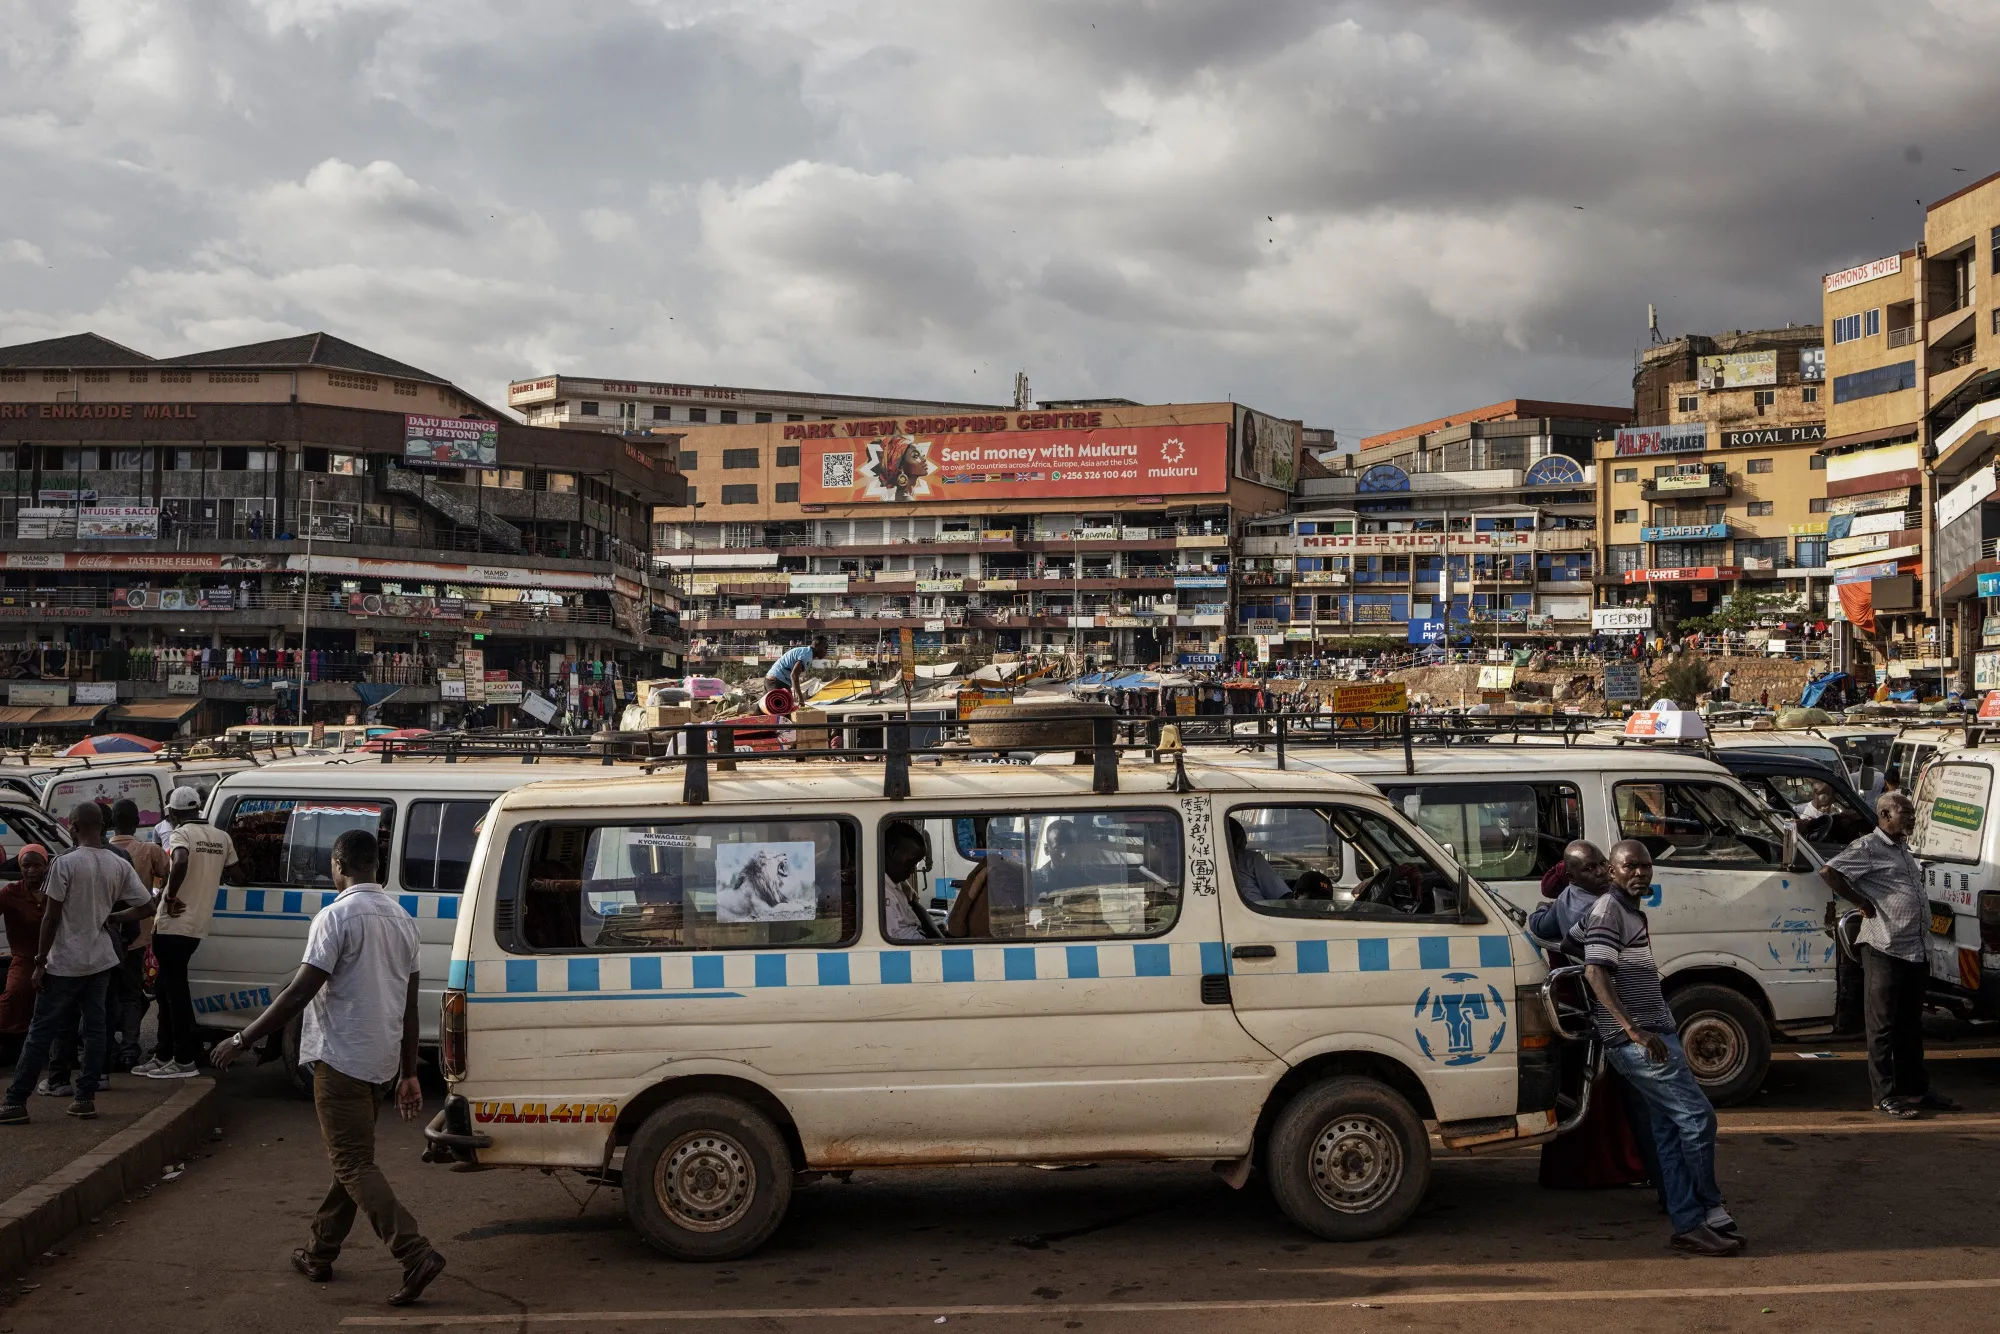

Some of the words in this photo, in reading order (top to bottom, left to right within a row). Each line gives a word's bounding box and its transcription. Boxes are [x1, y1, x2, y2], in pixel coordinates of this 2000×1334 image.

[1827, 267, 1869, 288] DIAMONDS
[1872, 256, 1899, 278] HOTEL
[512, 383, 534, 395] CORNER
[536, 380, 554, 390] HOUSE
[603, 382, 638, 393] GRAND
[650, 385, 692, 397] CORNER
[703, 389, 737, 400] HOUSE
[40, 404, 133, 419] ENKADDE
[144, 404, 196, 418] MALL
[409, 416, 439, 427] DAJU
[441, 419, 496, 432] BEDDINGS
[784, 423, 836, 439] PARK
[842, 420, 897, 437] VIEW
[905, 415, 1006, 434] SHOPPING
[1017, 411, 1102, 429] CENTRE
[425, 427, 433, 436] &
[435, 428, 480, 440] BEYOND
[1732, 431, 1783, 445] ROYAL
[1660, 435, 1704, 451] SPEAKER
[941, 447, 980, 462] Send
[984, 448, 1035, 463] money
[1040, 444, 1074, 459] with
[1078, 443, 1138, 457] Mukuru
[977, 462, 1007, 470] countries
[1031, 460, 1051, 469] Africa,
[1053, 460, 1079, 469] Europe,
[1061, 471, 1080, 480] +256
[1082, 471, 1101, 479] 326
[1103, 470, 1120, 478] 100
[1121, 470, 1137, 478] 401
[1148, 466, 1198, 478] mukuru
[80, 508, 121, 516] NTUUSE
[125, 508, 158, 516] SACCO
[1661, 525, 1712, 537] SMART
[1303, 534, 1433, 547] MAJESTIC
[1440, 533, 1528, 545] PLAA
[78, 555, 112, 567] Coca-Cola
[128, 557, 155, 566] TASTE
[156, 557, 174, 566] THE
[175, 557, 213, 566] FEELING
[484, 569, 508, 577] MAMBO
[1, 608, 28, 616] PARK
[1187, 654, 1216, 662] TECNO
[1375, 685, 1397, 693] STAGE
[638, 839, 697, 847] KYONGYAGALIZA
[644, 833, 691, 841] NKWAGALIZA
